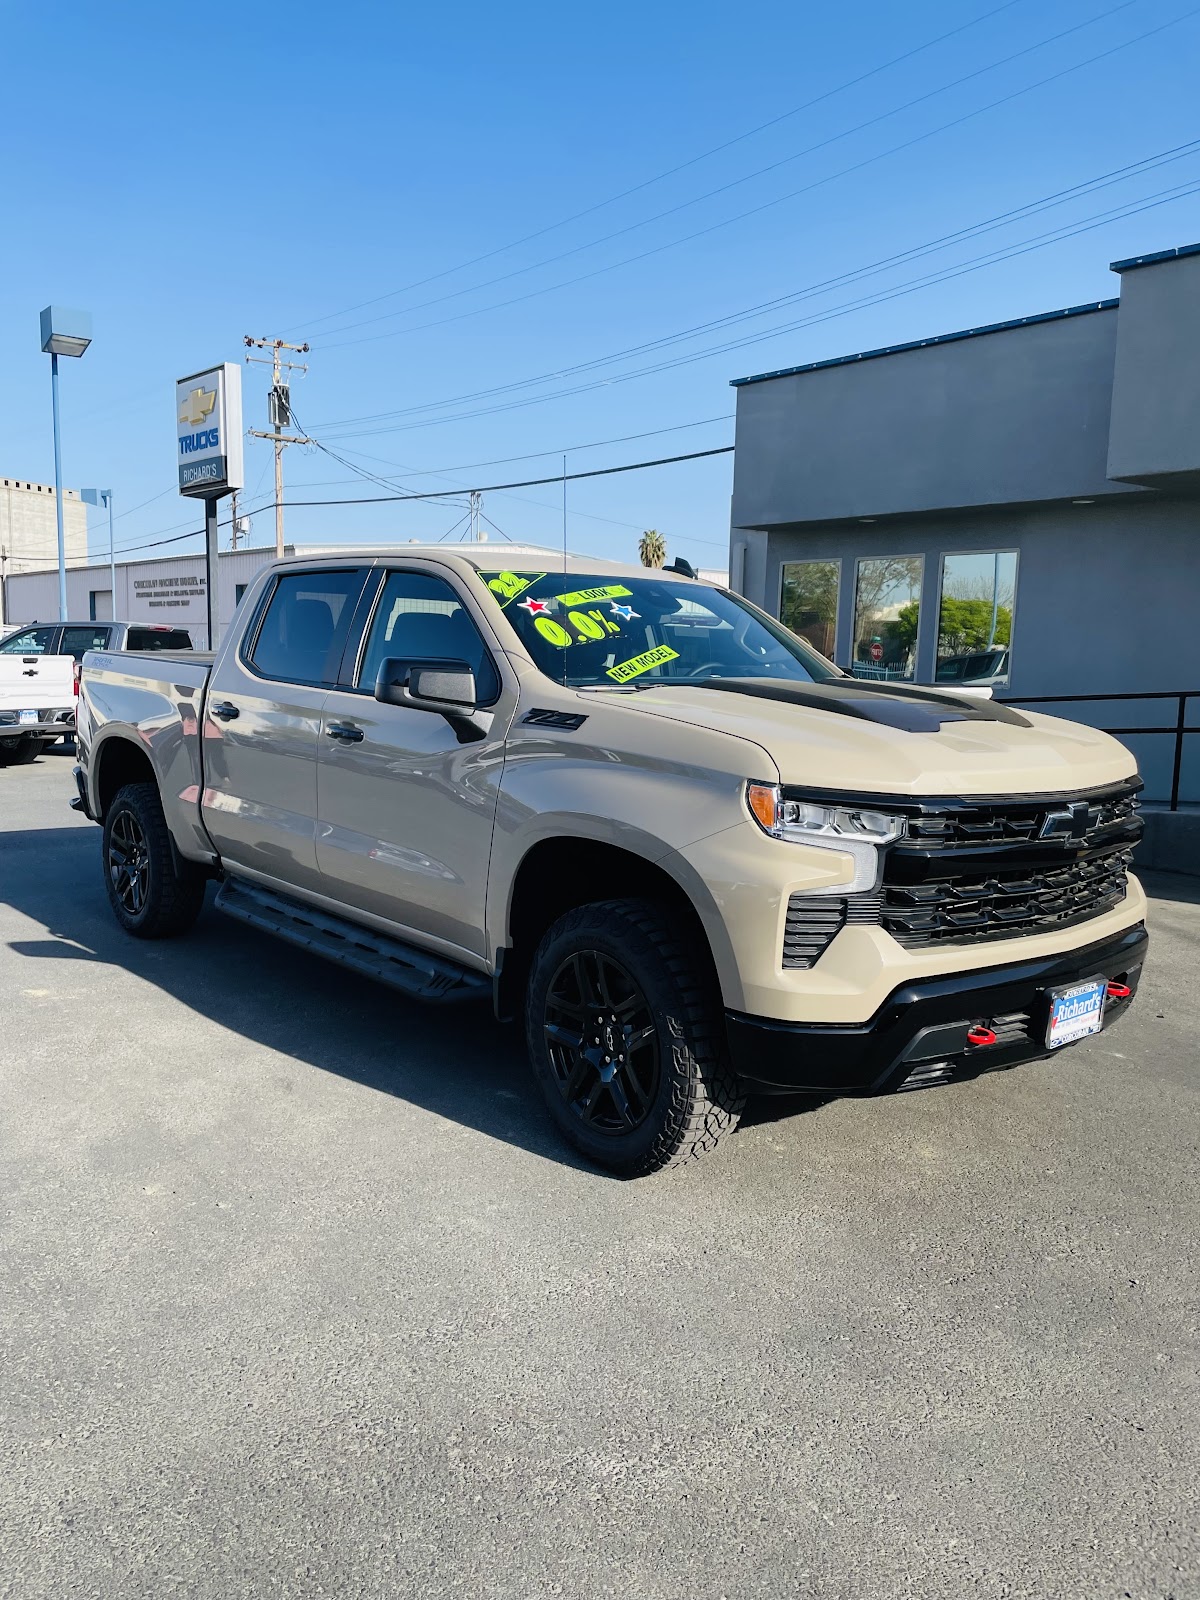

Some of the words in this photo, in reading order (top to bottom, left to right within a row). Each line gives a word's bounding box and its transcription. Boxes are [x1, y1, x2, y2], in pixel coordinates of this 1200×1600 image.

[179, 428, 218, 454] TRUCKS
[183, 464, 217, 482] RICHARD'S
[578, 587, 609, 599] LOOK
[534, 609, 620, 647] 0.0%
[610, 663, 638, 681] NEW
[637, 647, 673, 668] MODEL
[522, 708, 589, 730] Z71
[1058, 993, 1101, 1021] Richard's
